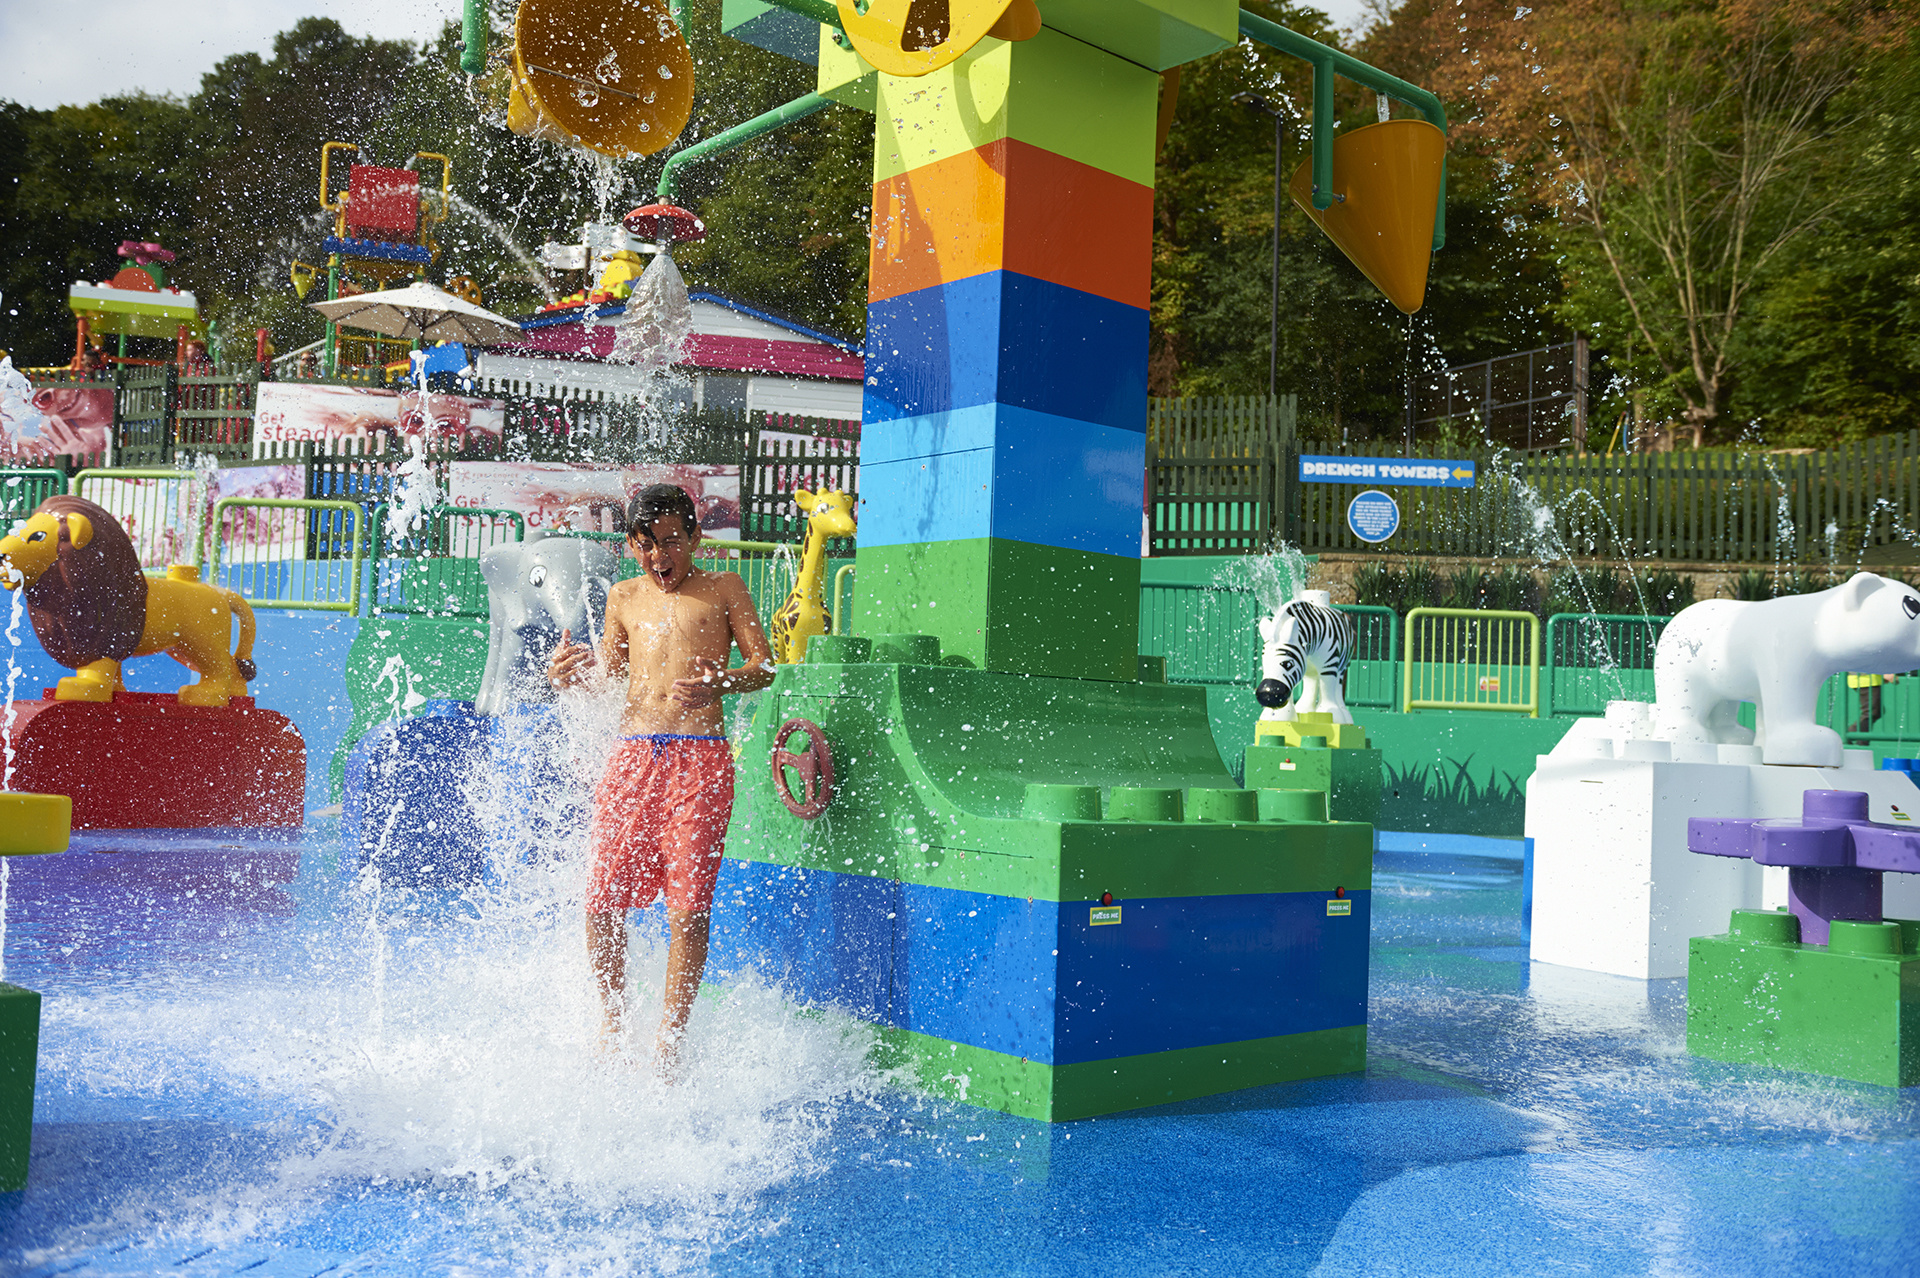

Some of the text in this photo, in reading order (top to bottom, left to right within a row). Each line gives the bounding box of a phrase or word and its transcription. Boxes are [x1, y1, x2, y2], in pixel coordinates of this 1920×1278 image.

[260, 412, 285, 424] Get
[1303, 462, 1450, 480] DRENCH TOWERS
[1092, 912, 1110, 920] PRESS
